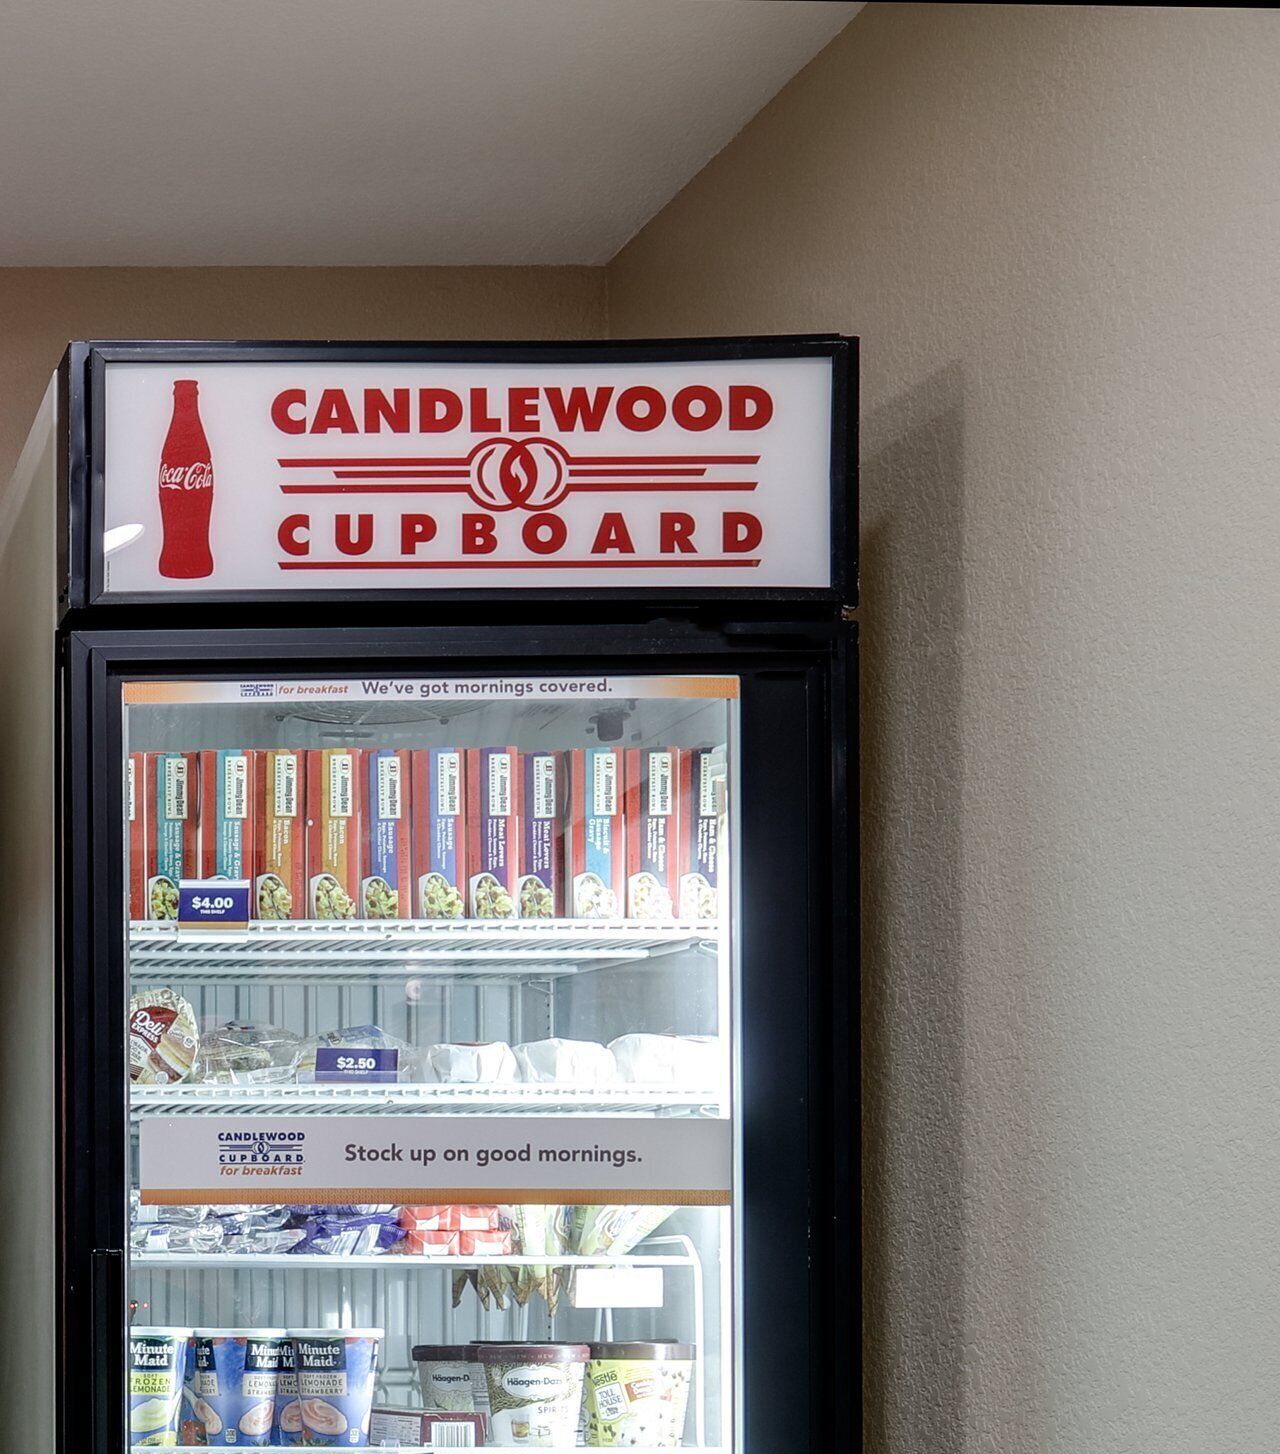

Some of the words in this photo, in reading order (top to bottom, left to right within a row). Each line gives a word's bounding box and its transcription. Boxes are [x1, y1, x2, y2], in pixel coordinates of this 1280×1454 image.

[270, 383, 775, 435] CANDLEWOOD
[159, 462, 213, 491] Coca-Cola
[277, 511, 764, 557] CUPBOARD
[278, 685, 295, 696] for
[297, 684, 349, 695] breakfast
[361, 680, 414, 695] We've
[420, 682, 449, 698] got
[454, 680, 534, 698] mornings
[539, 679, 613, 694] covered.
[192, 896, 234, 909] $4.00
[135, 1010, 165, 1036] Deli
[131, 1022, 159, 1044] EXPRESS
[336, 1057, 376, 1070] $2.50
[217, 1132, 306, 1142] CANDLEWOOD
[218, 1153, 303, 1164] CUPBOARD
[344, 1143, 404, 1164] Stock
[410, 1147, 436, 1168] up
[443, 1147, 470, 1164] on
[476, 1142, 532, 1168] good
[538, 1143, 643, 1168] mornings.
[220, 1164, 239, 1177] for
[241, 1164, 303, 1177] breakfast
[130, 1342, 175, 1356] Minute
[298, 1343, 340, 1355] Minute
[134, 1354, 168, 1367] Maid
[303, 1355, 335, 1367] Maid
[301, 1378, 343, 1387] LEMONADE
